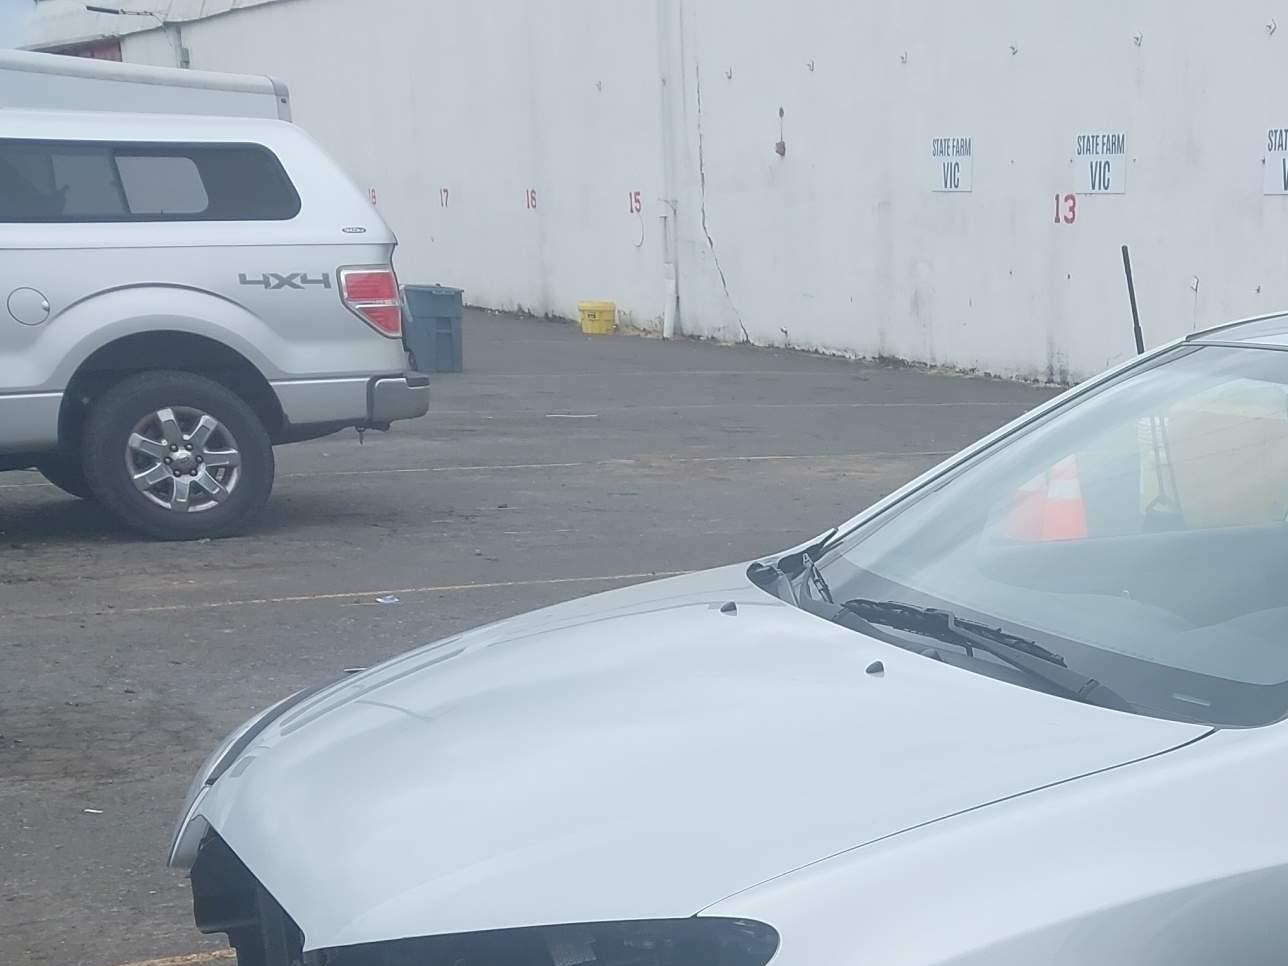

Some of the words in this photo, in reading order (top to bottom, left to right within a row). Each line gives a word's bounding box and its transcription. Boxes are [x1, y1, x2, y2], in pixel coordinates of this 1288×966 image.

[932, 138, 951, 156] STATE
[952, 138, 971, 156] FARM
[1077, 135, 1099, 155] STATE
[1102, 134, 1124, 154] FARM
[943, 162, 960, 188] VIC
[1090, 161, 1110, 190] VIC
[440, 188, 449, 207] 17
[526, 189, 537, 208] 16
[629, 192, 642, 213] 15
[1054, 194, 1076, 224] 13
[238, 272, 331, 290] 4X4
